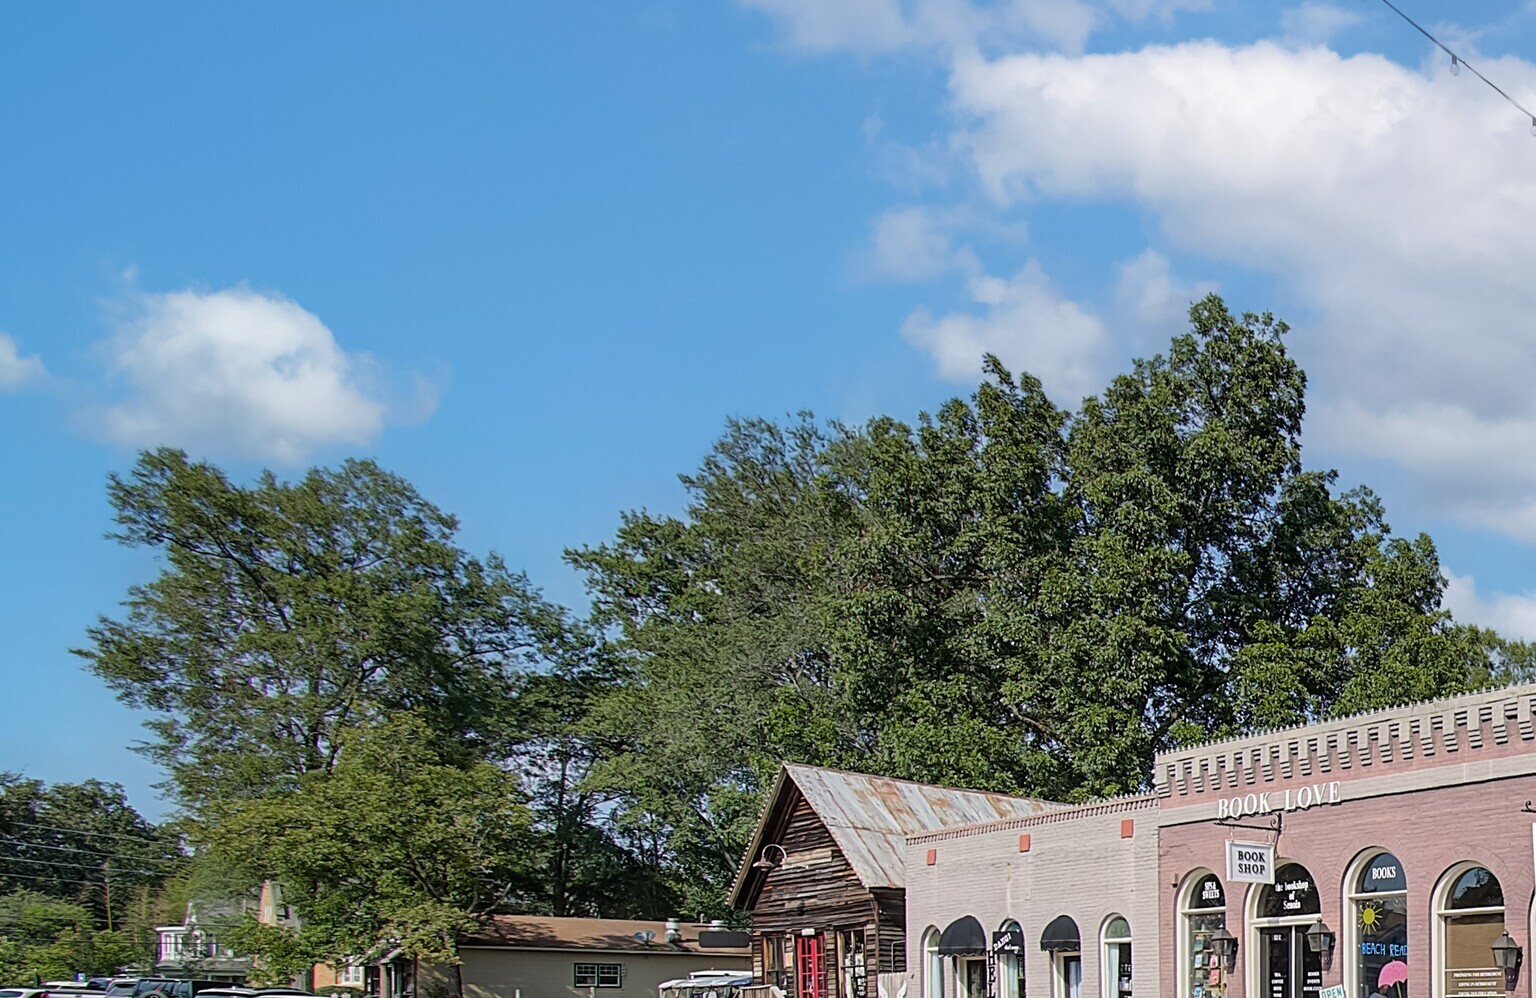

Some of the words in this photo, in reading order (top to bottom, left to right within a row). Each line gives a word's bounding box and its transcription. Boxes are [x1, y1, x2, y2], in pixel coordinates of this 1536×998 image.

[1218, 792, 1271, 818] BOOK
[1284, 781, 1341, 810] LOVE
[1238, 851, 1265, 862] BOOK
[1238, 864, 1265, 874] SHOP
[1372, 866, 1396, 880] BOOKS
[1362, 942, 1385, 956] BEACH
